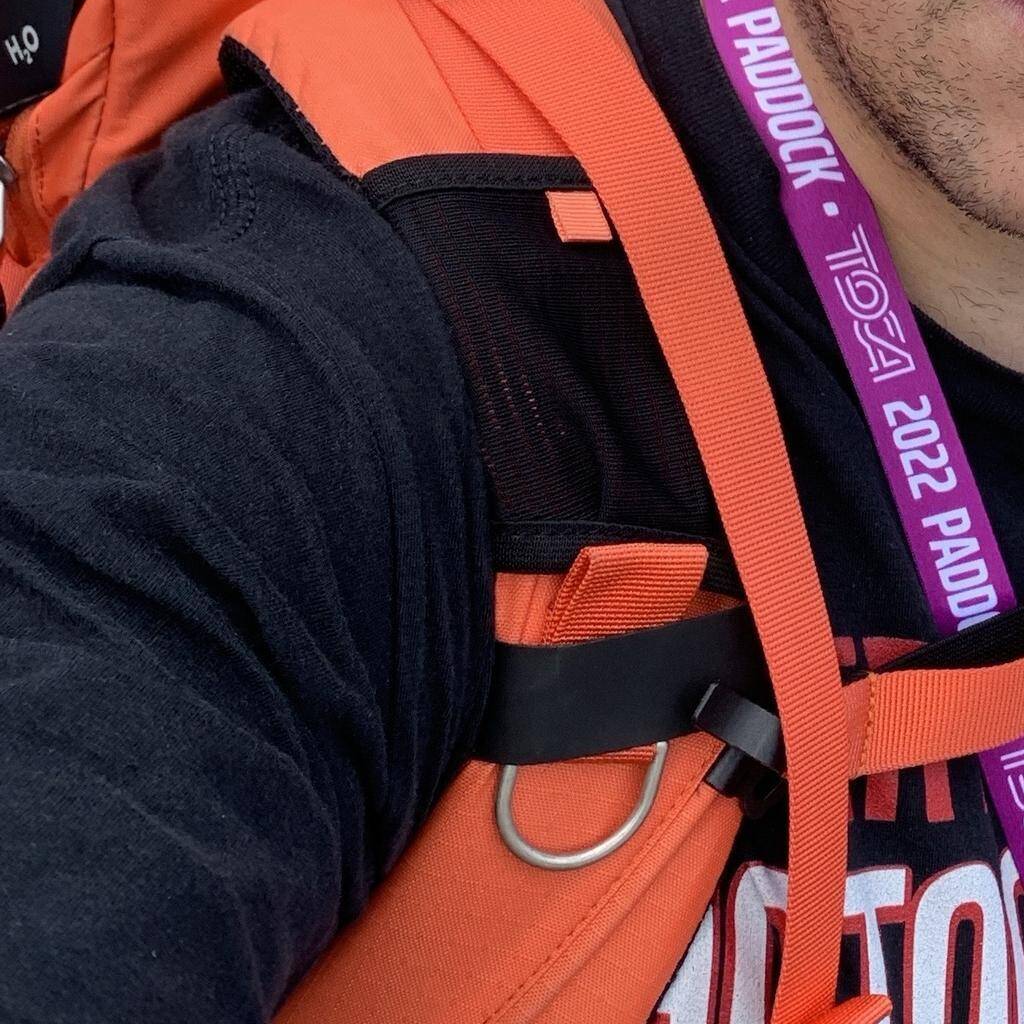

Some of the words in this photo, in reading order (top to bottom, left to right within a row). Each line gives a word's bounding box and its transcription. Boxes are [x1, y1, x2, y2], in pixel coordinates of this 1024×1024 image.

[727, 6, 845, 190] PADDOCK
[883, 394, 958, 500] 2022
[921, 506, 1000, 631] PADD
